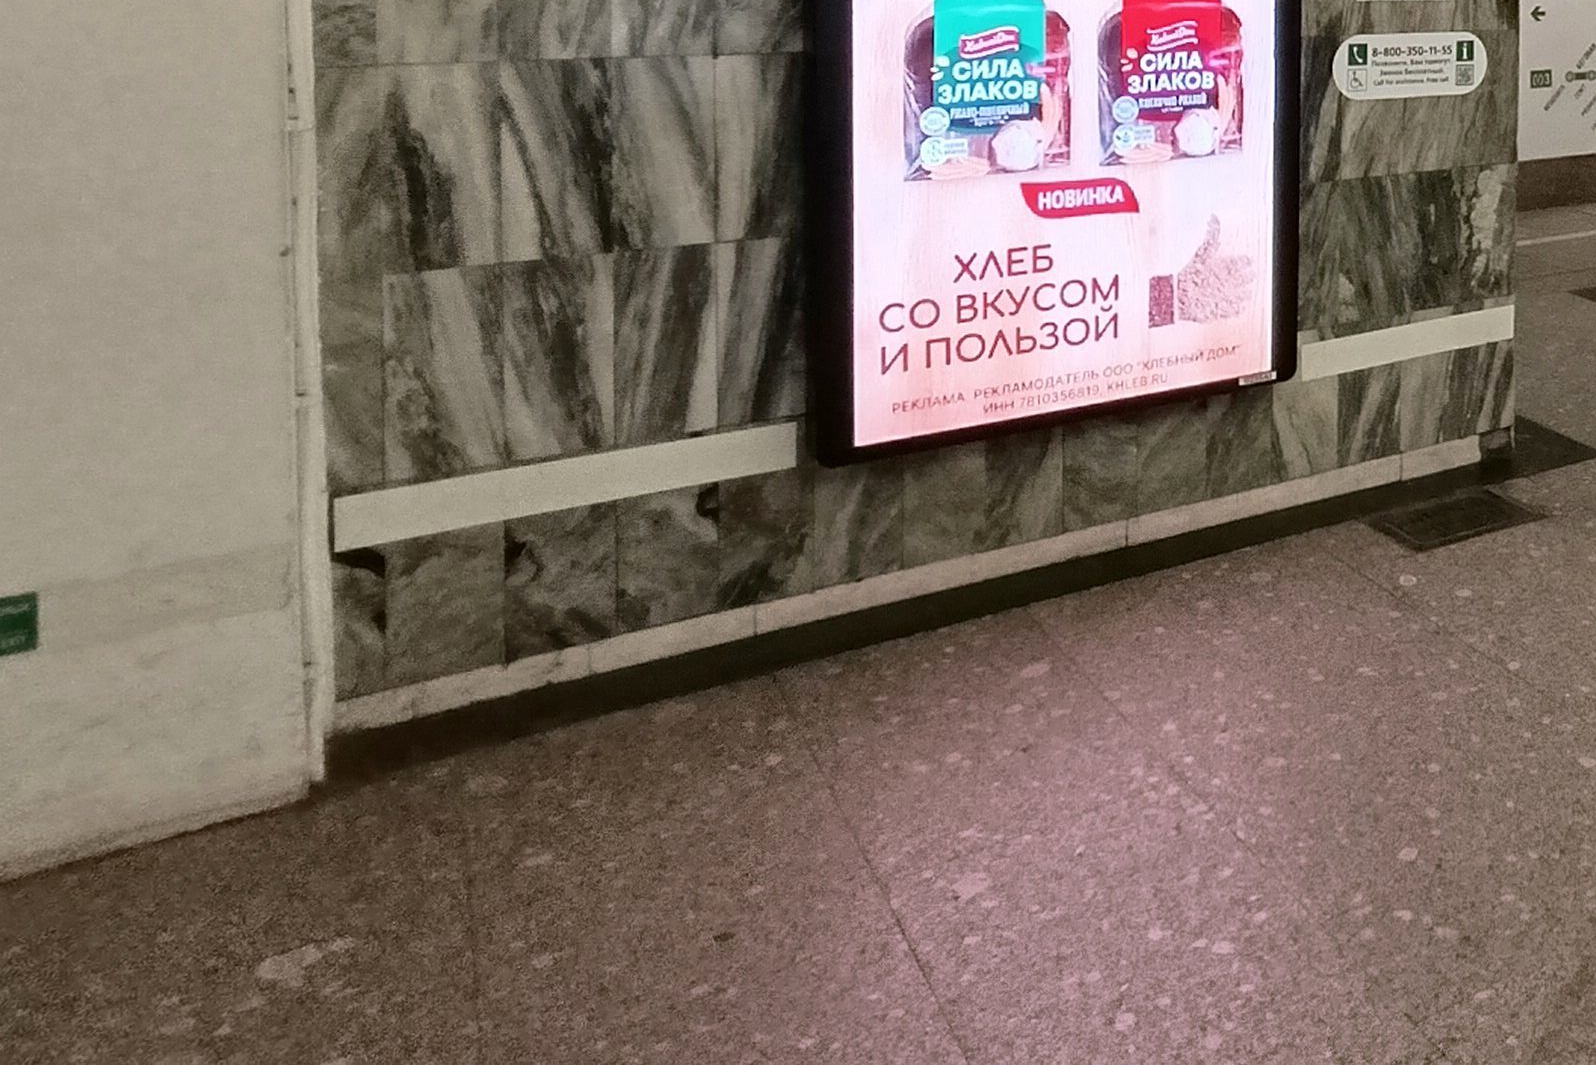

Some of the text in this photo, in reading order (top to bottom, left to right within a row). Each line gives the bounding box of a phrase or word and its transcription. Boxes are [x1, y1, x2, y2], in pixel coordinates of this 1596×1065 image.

[1140, 51, 1203, 72] СИЛА
[1372, 45, 1452, 57] 8-800-350-11-55
[952, 58, 1024, 81] СИЛА
[938, 81, 1038, 104] ЗЛАКОВ
[1127, 71, 1215, 94] ЗЛАКОВ
[1038, 184, 1124, 211] НОВИНКА
[954, 244, 1054, 283] ХЛЕБ
[879, 274, 1120, 333] СО ВКУСОМ
[881, 308, 1119, 375] И ПОЛЬЗОЙ
[974, 370, 1099, 399] РЕКЛАМОДАТЕЛЬ
[1103, 363, 1133, 378] ООО
[983, 401, 1015, 414] ИНН
